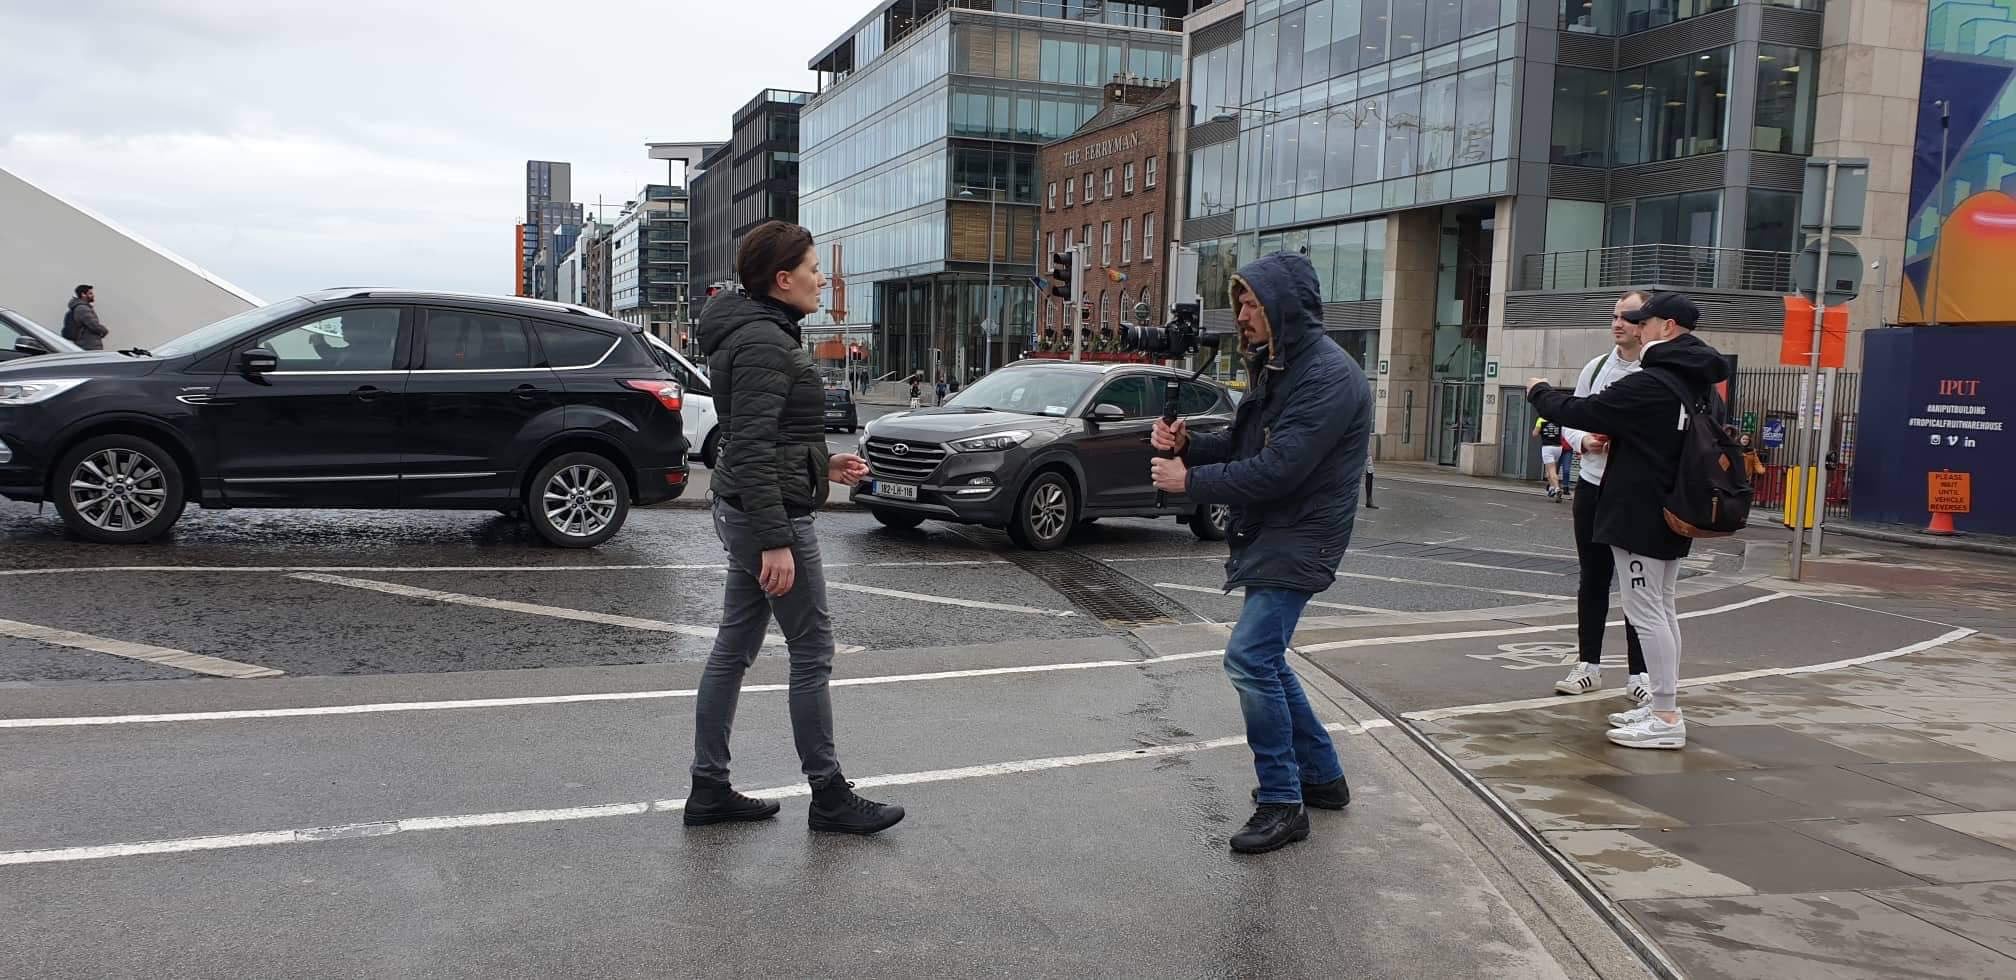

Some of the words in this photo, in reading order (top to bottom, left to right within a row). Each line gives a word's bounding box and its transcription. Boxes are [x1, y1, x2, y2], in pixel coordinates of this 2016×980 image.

[1063, 149, 1081, 168] THE
[1085, 131, 1139, 161] FERRYMAN
[1939, 380, 1980, 396] IPUT
[1909, 418, 2003, 430] #TROPICALFRUITWAREHOUSE
[1629, 553, 1646, 589] CE
